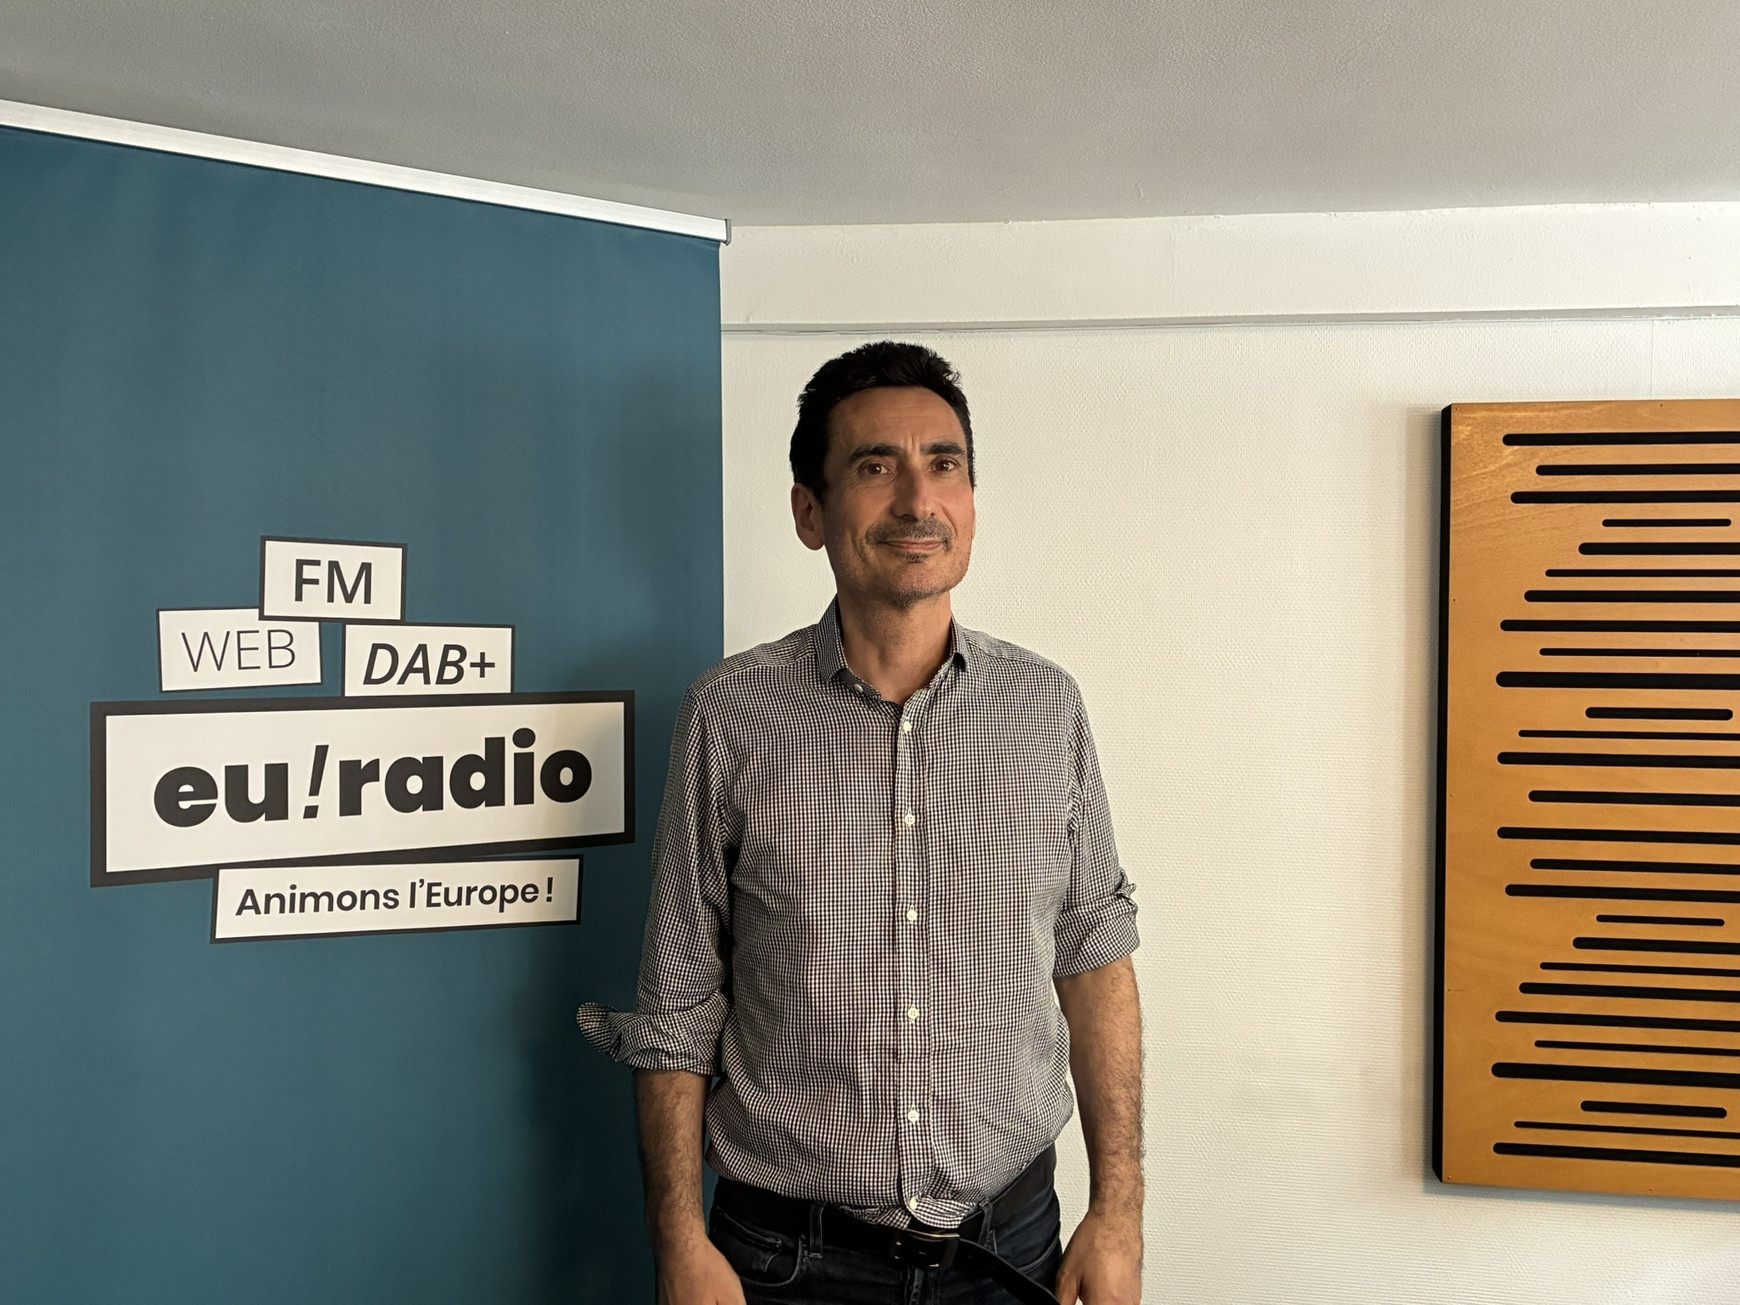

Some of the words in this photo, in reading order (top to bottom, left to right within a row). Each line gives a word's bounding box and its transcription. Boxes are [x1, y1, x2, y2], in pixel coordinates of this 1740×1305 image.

[295, 559, 372, 604] FM
[181, 629, 295, 672] WEB
[363, 643, 495, 685] DAB+
[154, 728, 592, 827] eu!radio
[236, 884, 399, 915] Animons
